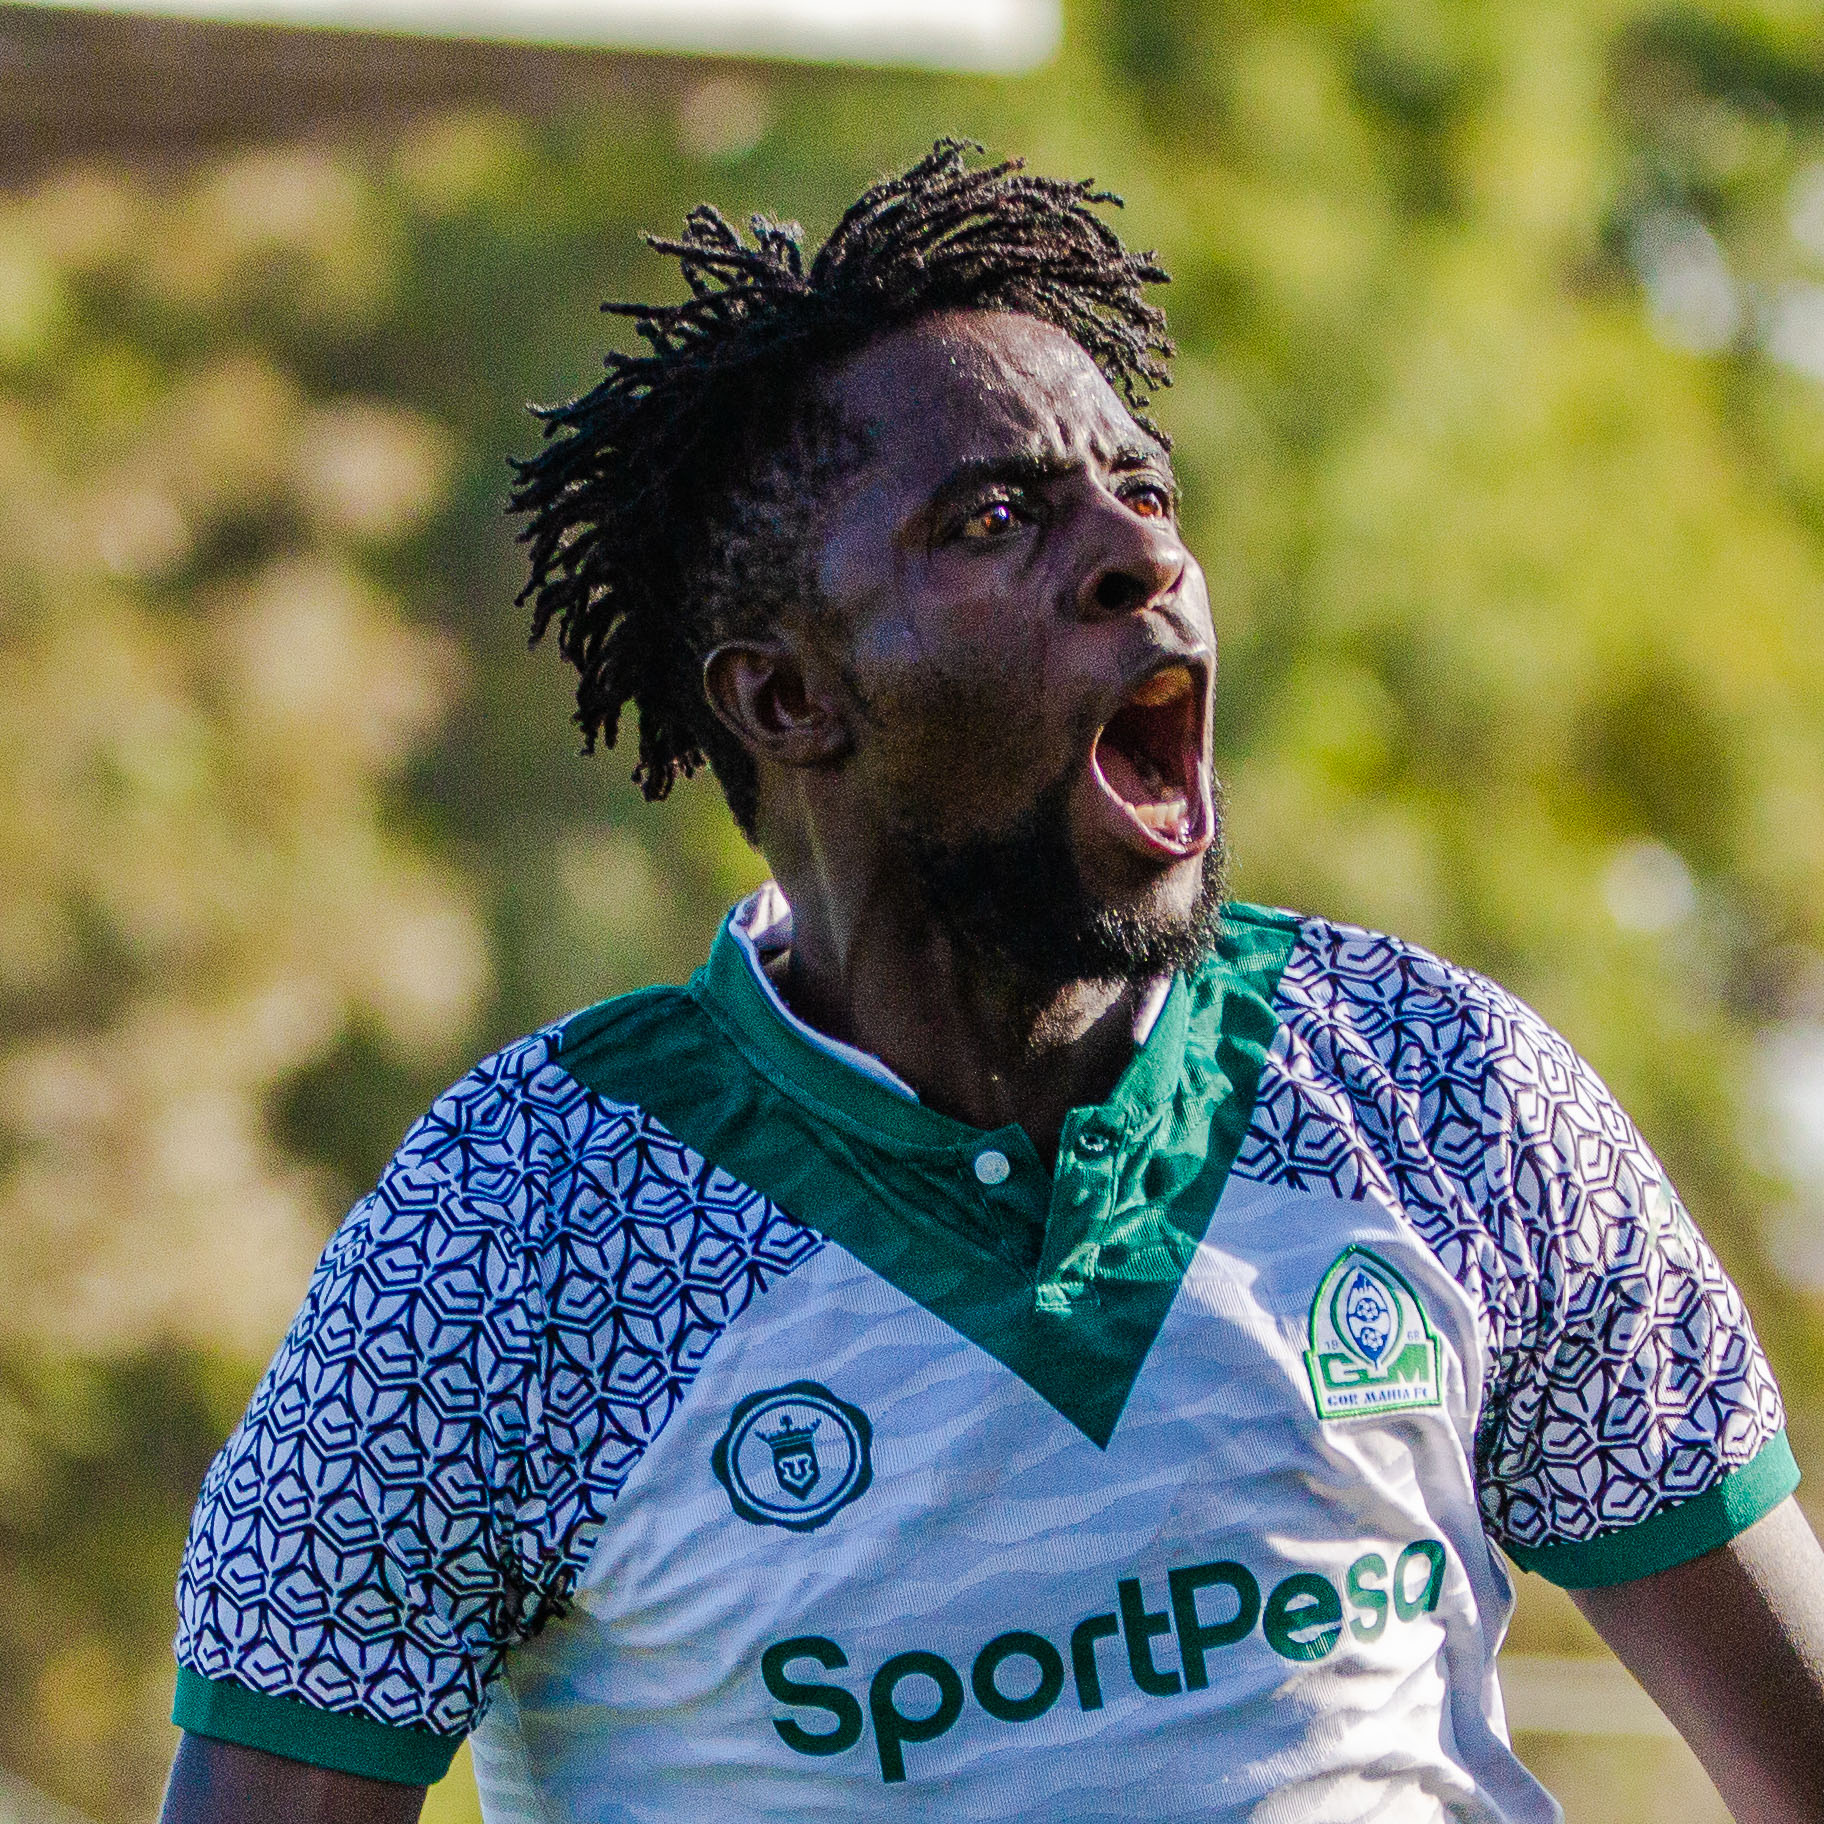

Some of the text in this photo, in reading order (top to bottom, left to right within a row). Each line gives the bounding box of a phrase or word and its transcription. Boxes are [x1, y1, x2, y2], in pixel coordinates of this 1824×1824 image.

[1327, 1391, 1359, 1406] GOR
[1364, 1387, 1410, 1405] MAHIA
[761, 1538, 1447, 1783] SportPesa
